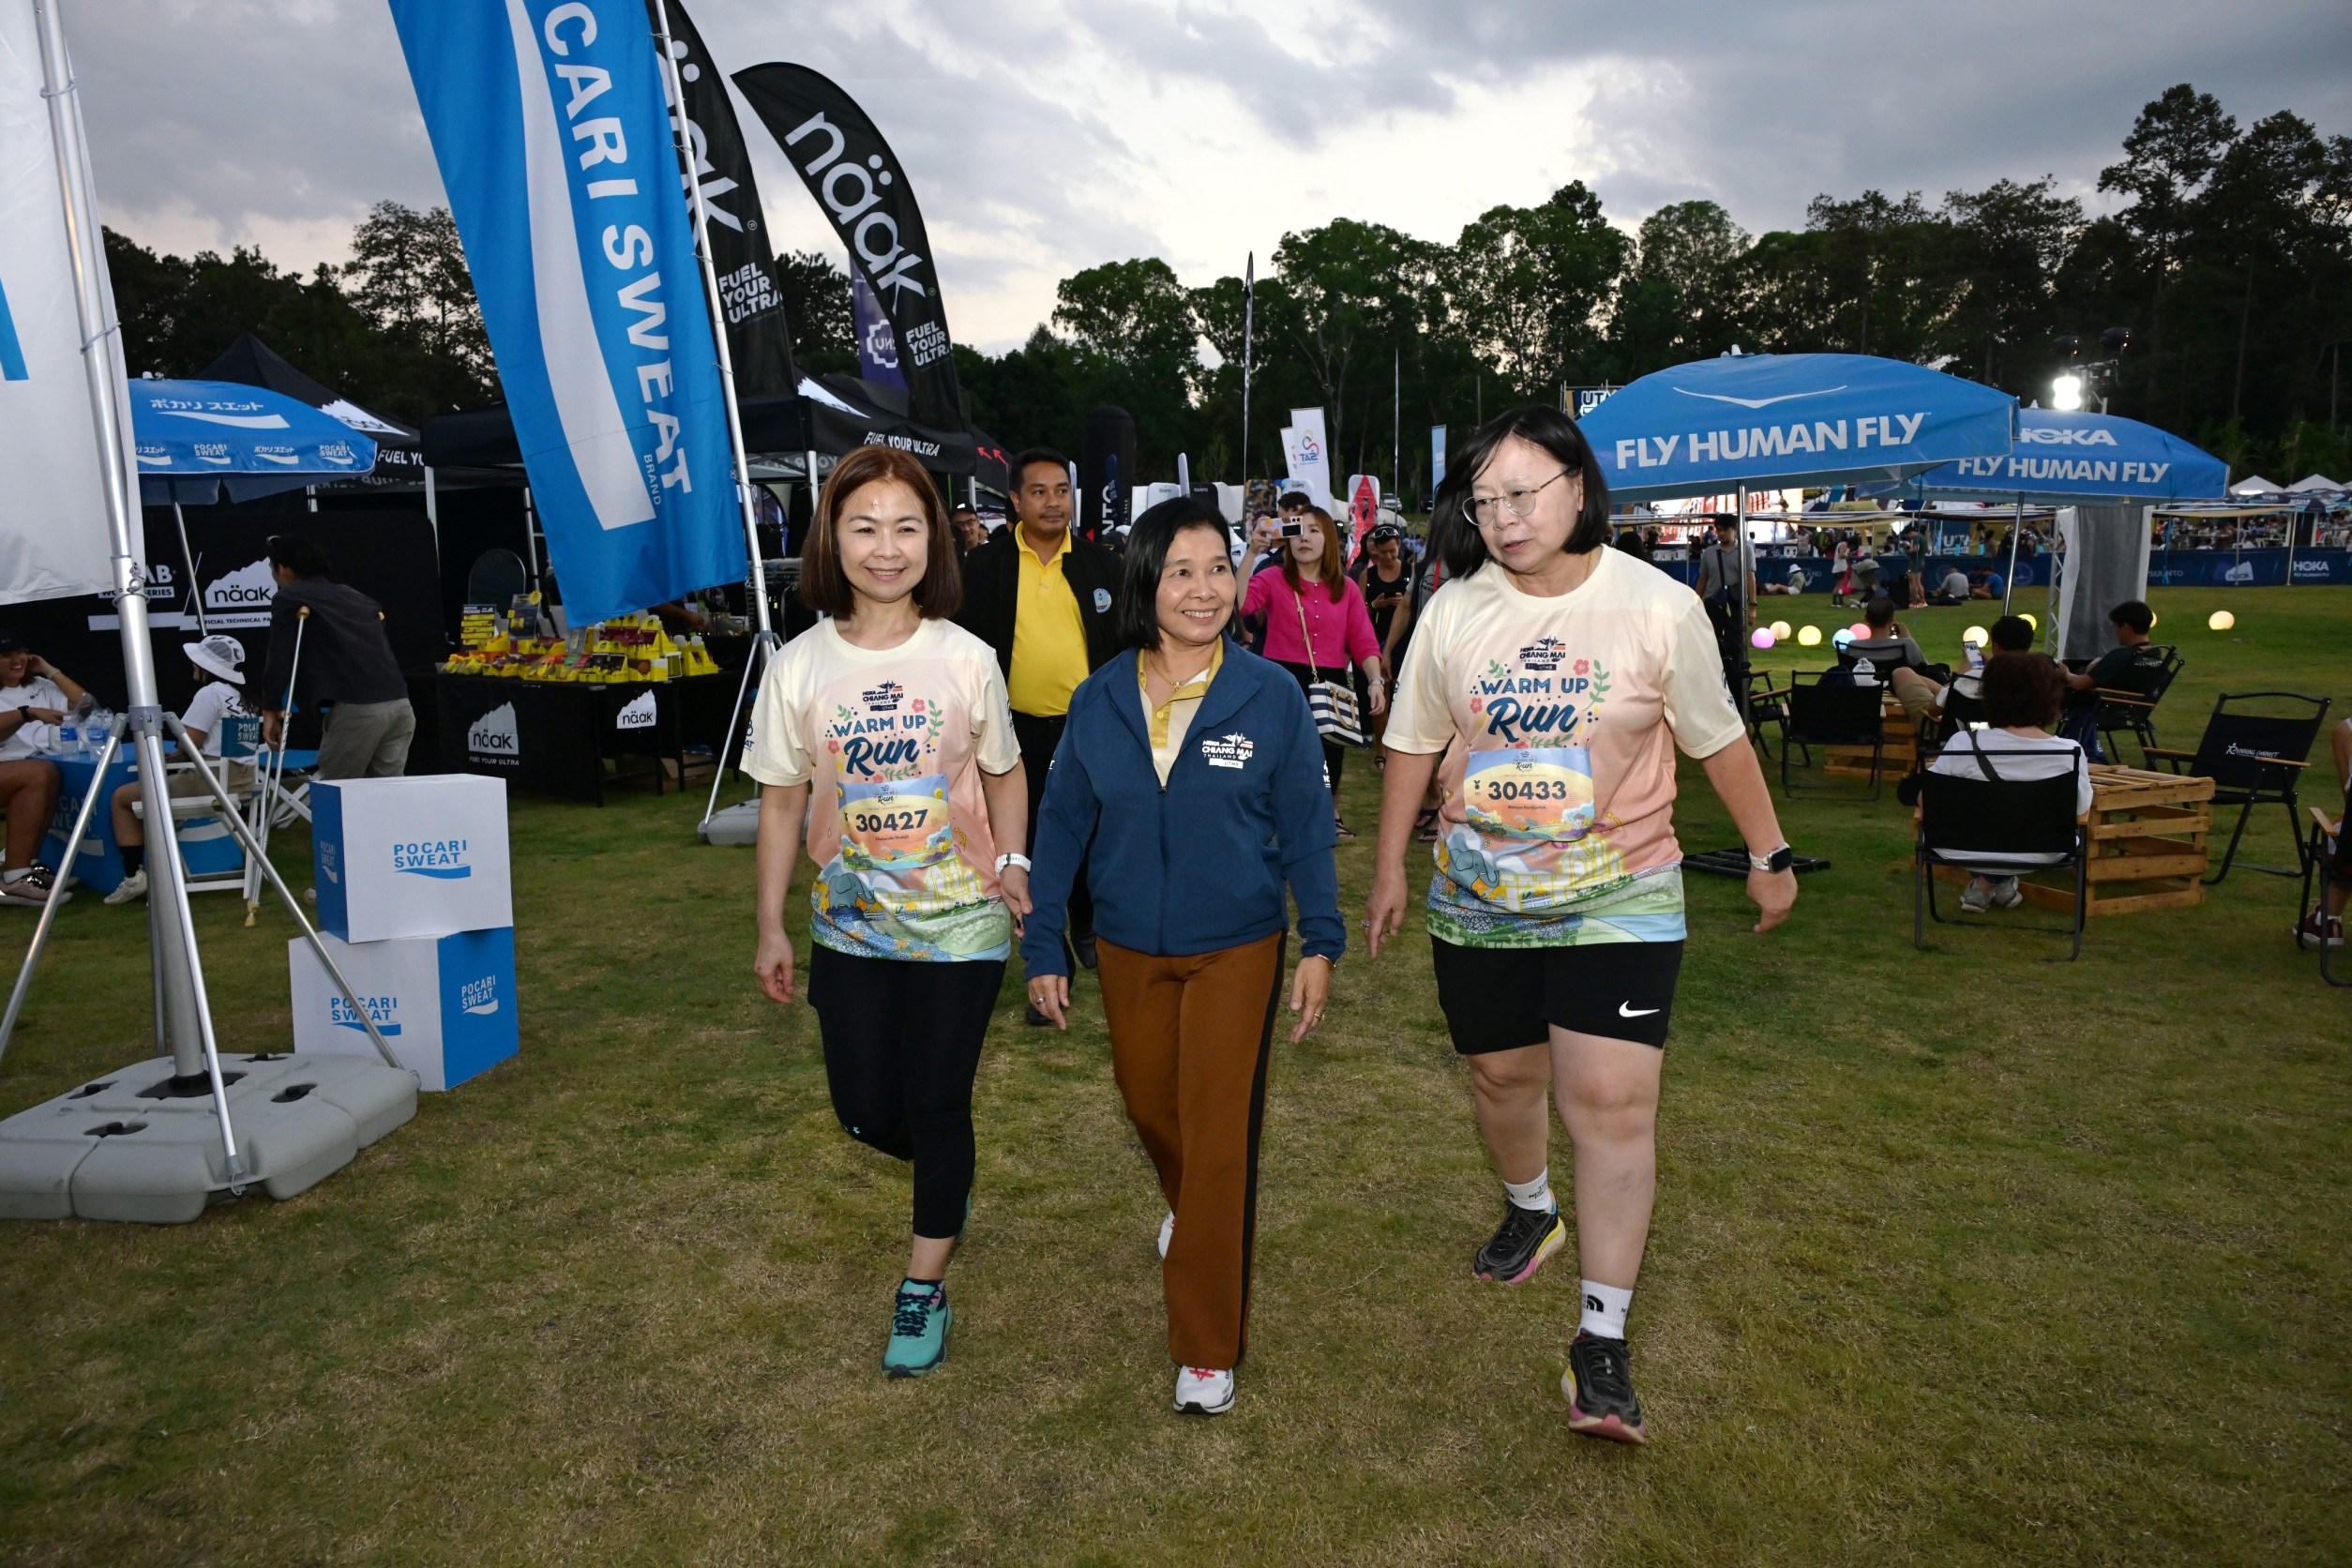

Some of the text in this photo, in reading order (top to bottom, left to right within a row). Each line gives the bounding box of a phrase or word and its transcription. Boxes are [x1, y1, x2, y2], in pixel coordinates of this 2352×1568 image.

[784, 111, 927, 316] näak
[545, 2, 692, 493] CARI SWEAT
[718, 262, 763, 293] FUEL
[722, 277, 771, 309] YOUR
[906, 320, 940, 343] FUEL
[909, 331, 946, 354] YOUR
[864, 431, 941, 457] FUEL YOUR ULTRA
[1616, 413, 1924, 469] FLY HUMAN FLY
[377, 449, 407, 464] FUEL
[643, 454, 661, 505] BRAND
[1958, 458, 2171, 484] FLY HUMAN FLY
[2293, 561, 2329, 571] HOKA
[214, 584, 272, 603] näak
[1480, 678, 1589, 695] WARM UP
[863, 694, 889, 702] CHIANG
[622, 710, 653, 725] näak
[833, 715, 927, 737] WARM UP
[1486, 697, 1578, 743] Run
[473, 729, 513, 749] näak
[844, 736, 920, 776] Run
[1236, 747, 1253, 758] MAI
[1515, 761, 1533, 771] Run
[1487, 780, 1566, 801] 30433
[855, 808, 928, 833] 30427
[320, 840, 336, 854] POCARI
[394, 839, 467, 856] POCARI
[321, 853, 335, 867] SWEAT
[394, 852, 460, 868] SWEAT
[461, 974, 496, 998] POCARI
[461, 988, 494, 1008] SWEAT
[331, 1009, 392, 1021] SWAT
